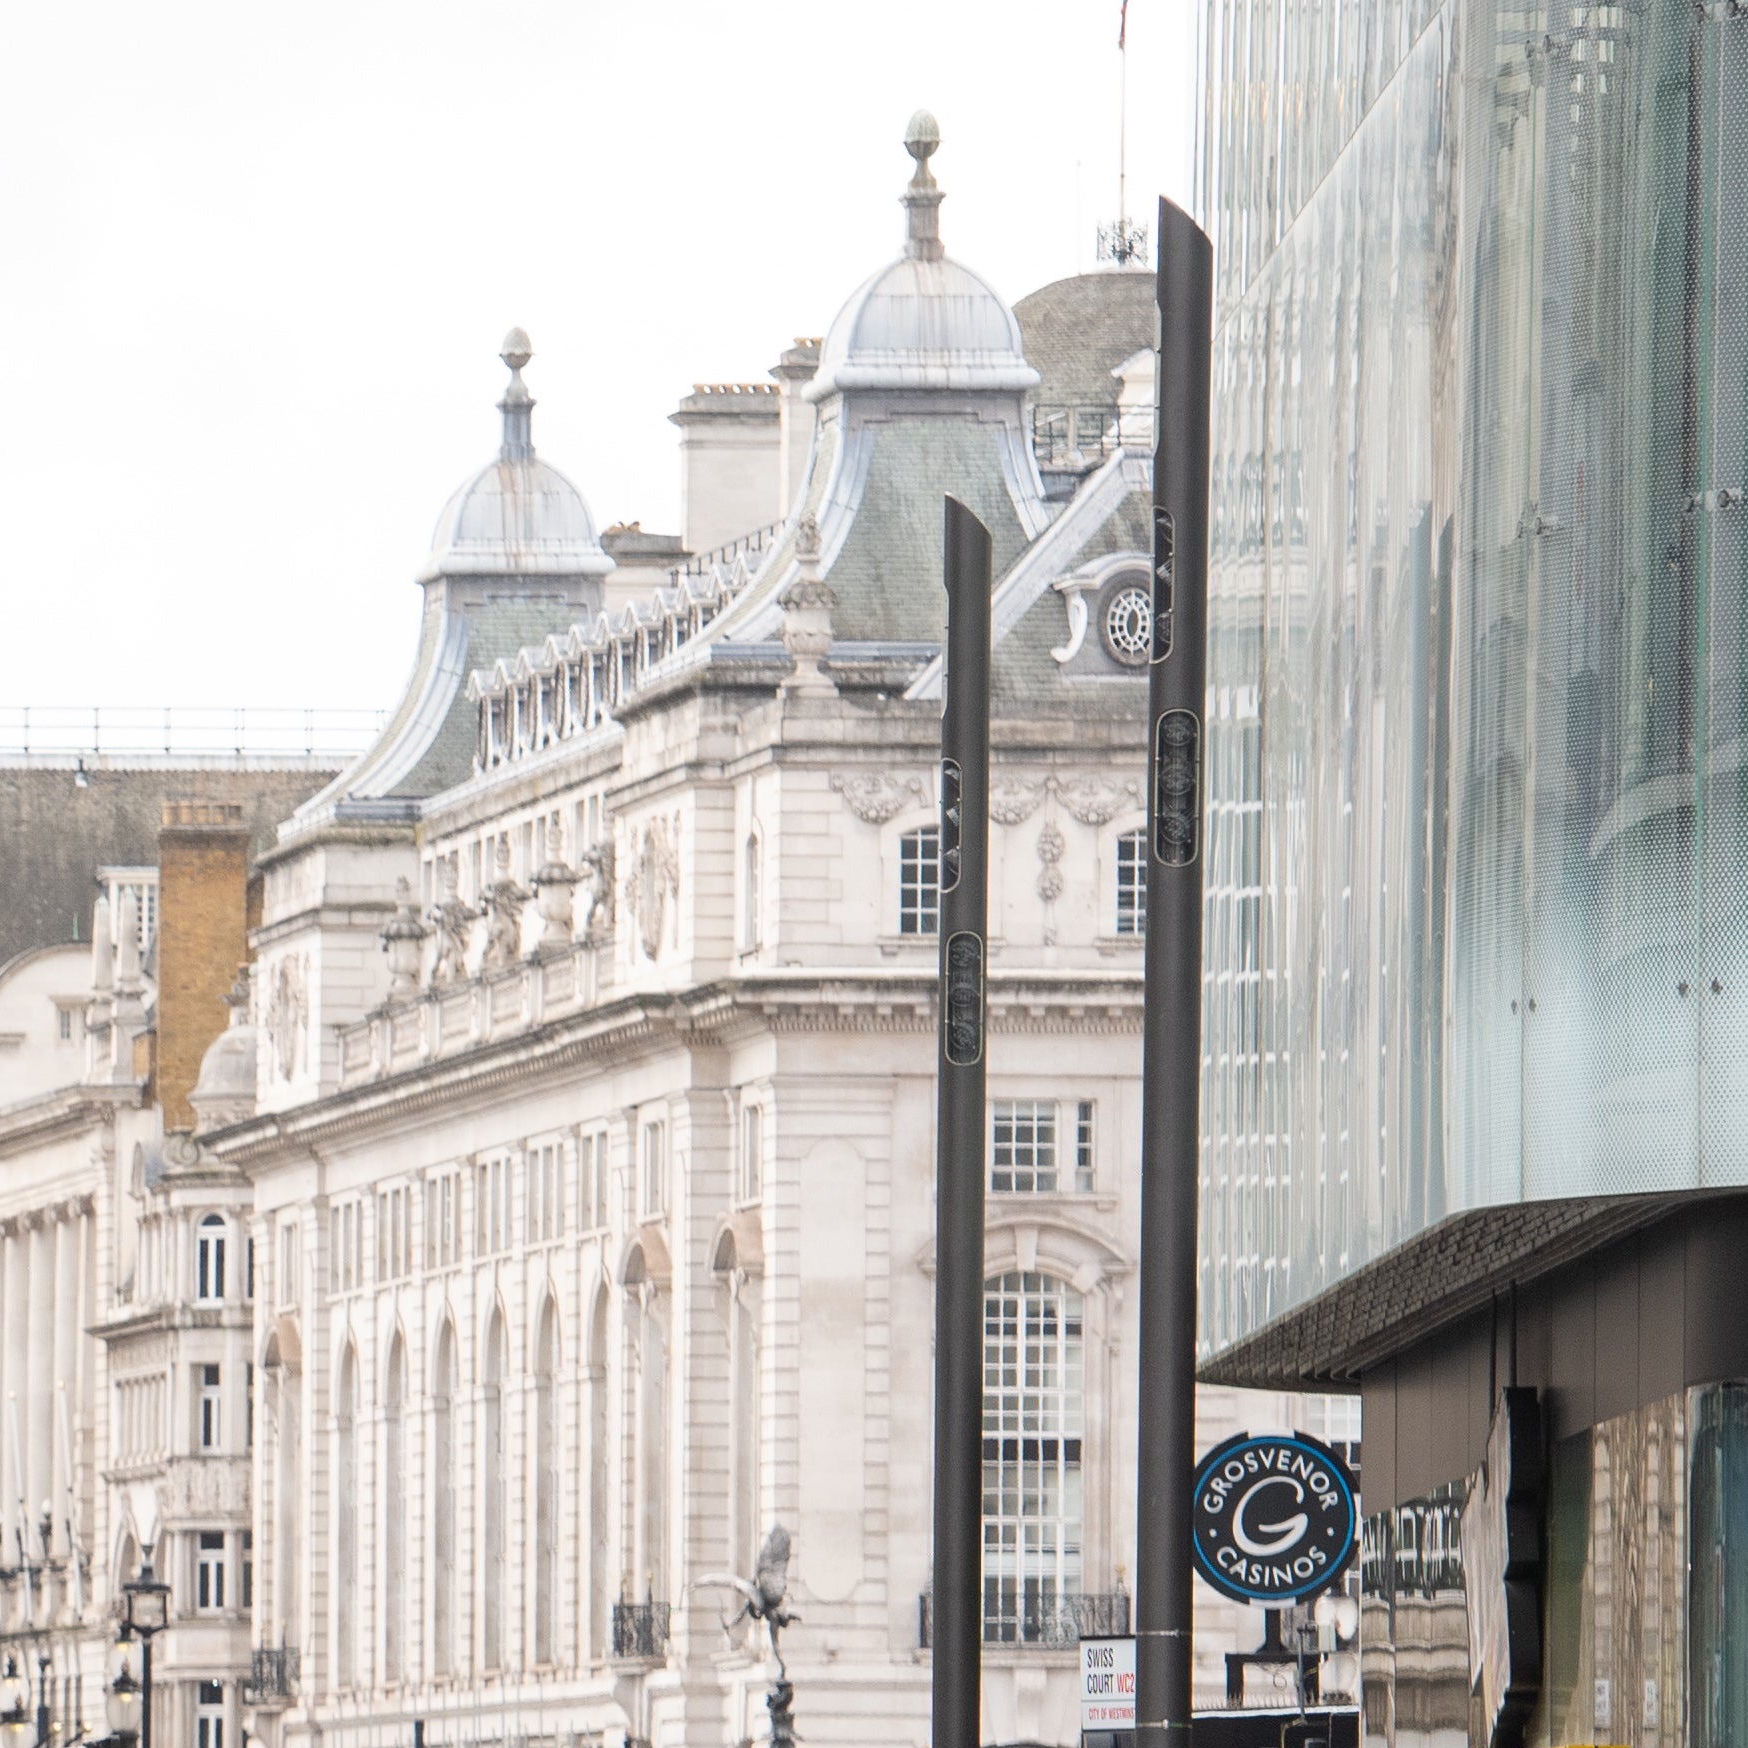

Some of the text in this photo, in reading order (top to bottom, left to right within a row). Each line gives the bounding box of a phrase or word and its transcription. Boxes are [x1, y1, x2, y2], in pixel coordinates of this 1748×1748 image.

[1203, 1448, 1339, 1514] GROSVENOR
[1232, 1475, 1309, 1557] G
[1216, 1545, 1327, 1587] CASINOS
[1087, 1647, 1114, 1668] SWISS
[1087, 1673, 1135, 1694] COURT WC2
[1088, 1707, 1100, 1720] CITY
[1109, 1707, 1134, 1720] WESTMINS
